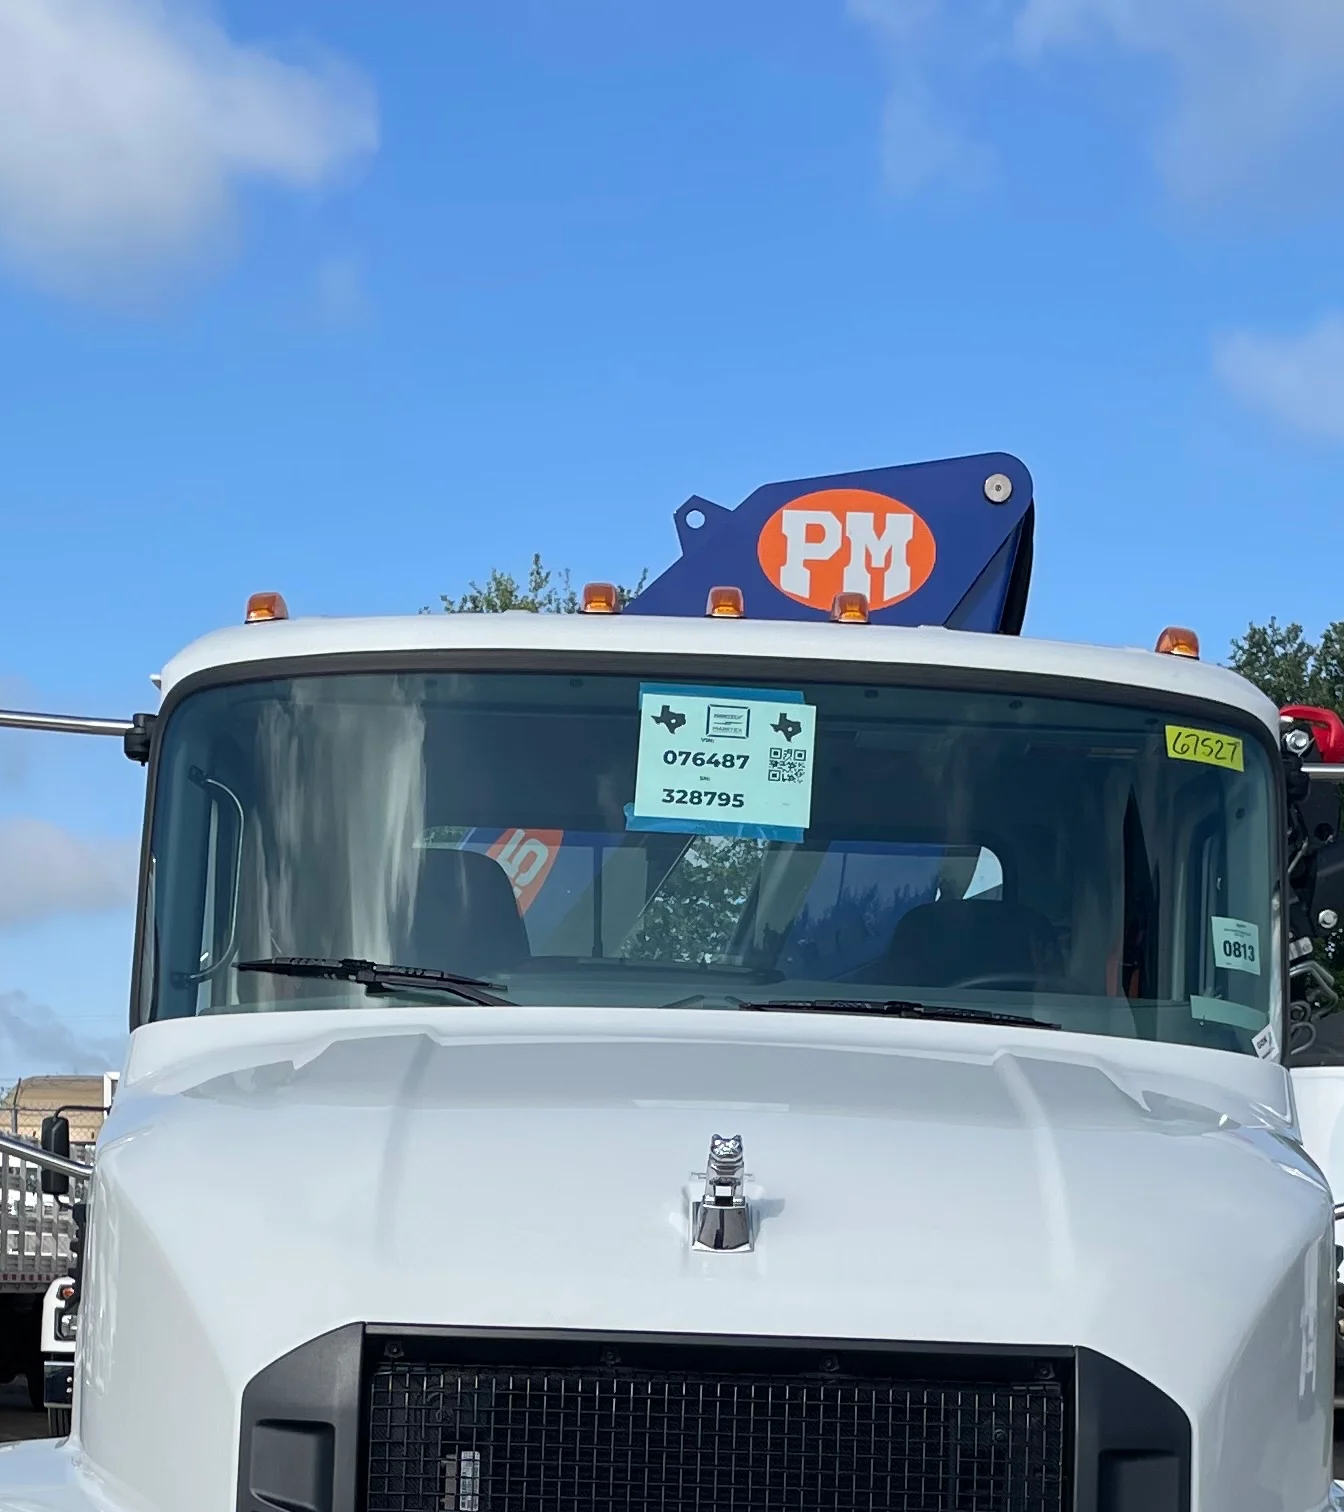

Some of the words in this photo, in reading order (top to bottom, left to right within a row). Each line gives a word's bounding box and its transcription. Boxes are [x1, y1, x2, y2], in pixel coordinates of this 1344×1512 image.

[780, 509, 913, 602] PM
[1172, 731, 1240, 764] 67527
[663, 750, 750, 769] 076487
[661, 788, 744, 808] 328795
[1223, 940, 1255, 962] 0813
